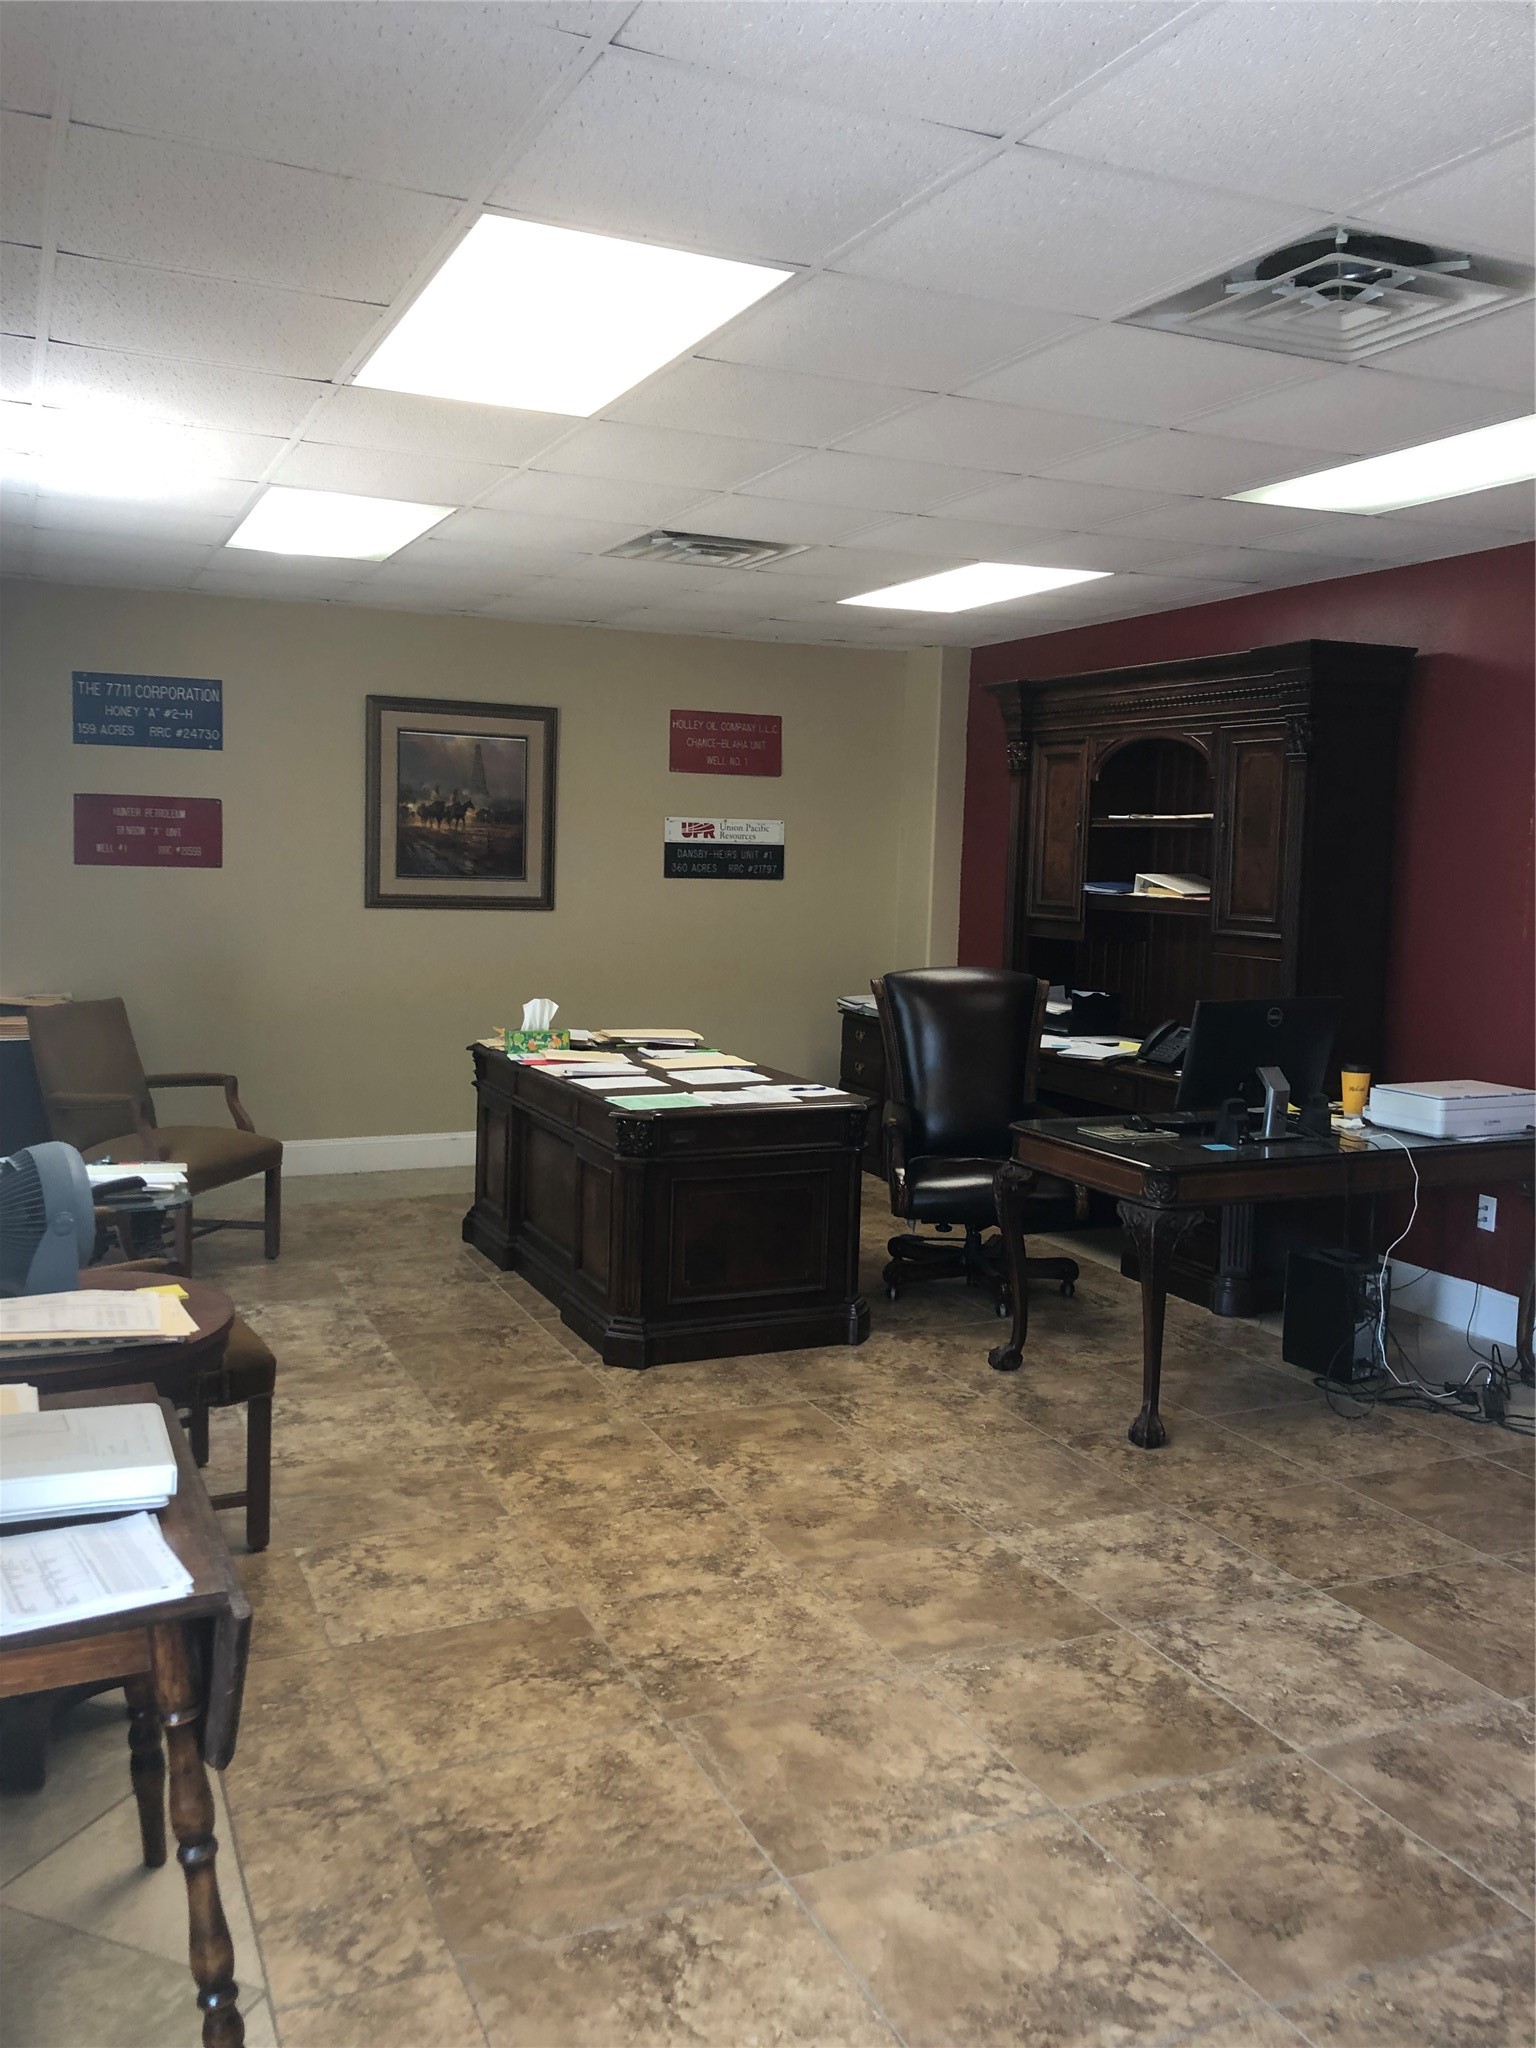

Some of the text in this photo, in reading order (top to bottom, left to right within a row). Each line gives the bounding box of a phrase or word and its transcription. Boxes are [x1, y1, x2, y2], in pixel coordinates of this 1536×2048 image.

[77, 681, 220, 702] THE 7711 CORPORATION
[105, 705, 193, 720] HONEY "A" #2-H
[77, 723, 220, 740] 159 ACRES RRC #24730
[672, 720, 704, 730] HOLLEY
[706, 721, 719, 731] OIL
[720, 722, 757, 733] COMPANY
[750, 741, 766, 751] UNIT
[706, 755, 727, 766] WELL
[144, 808, 186, 819] PETROLEUM
[681, 822, 715, 839] UPR
[719, 823, 770, 832] Union Pacific
[719, 832, 756, 840] Resources
[677, 849, 772, 860] DANSBY-HEIRS UNIT #1
[671, 863, 688, 873] 360
[691, 863, 718, 873] ACRES
[728, 864, 744, 873] RRC
